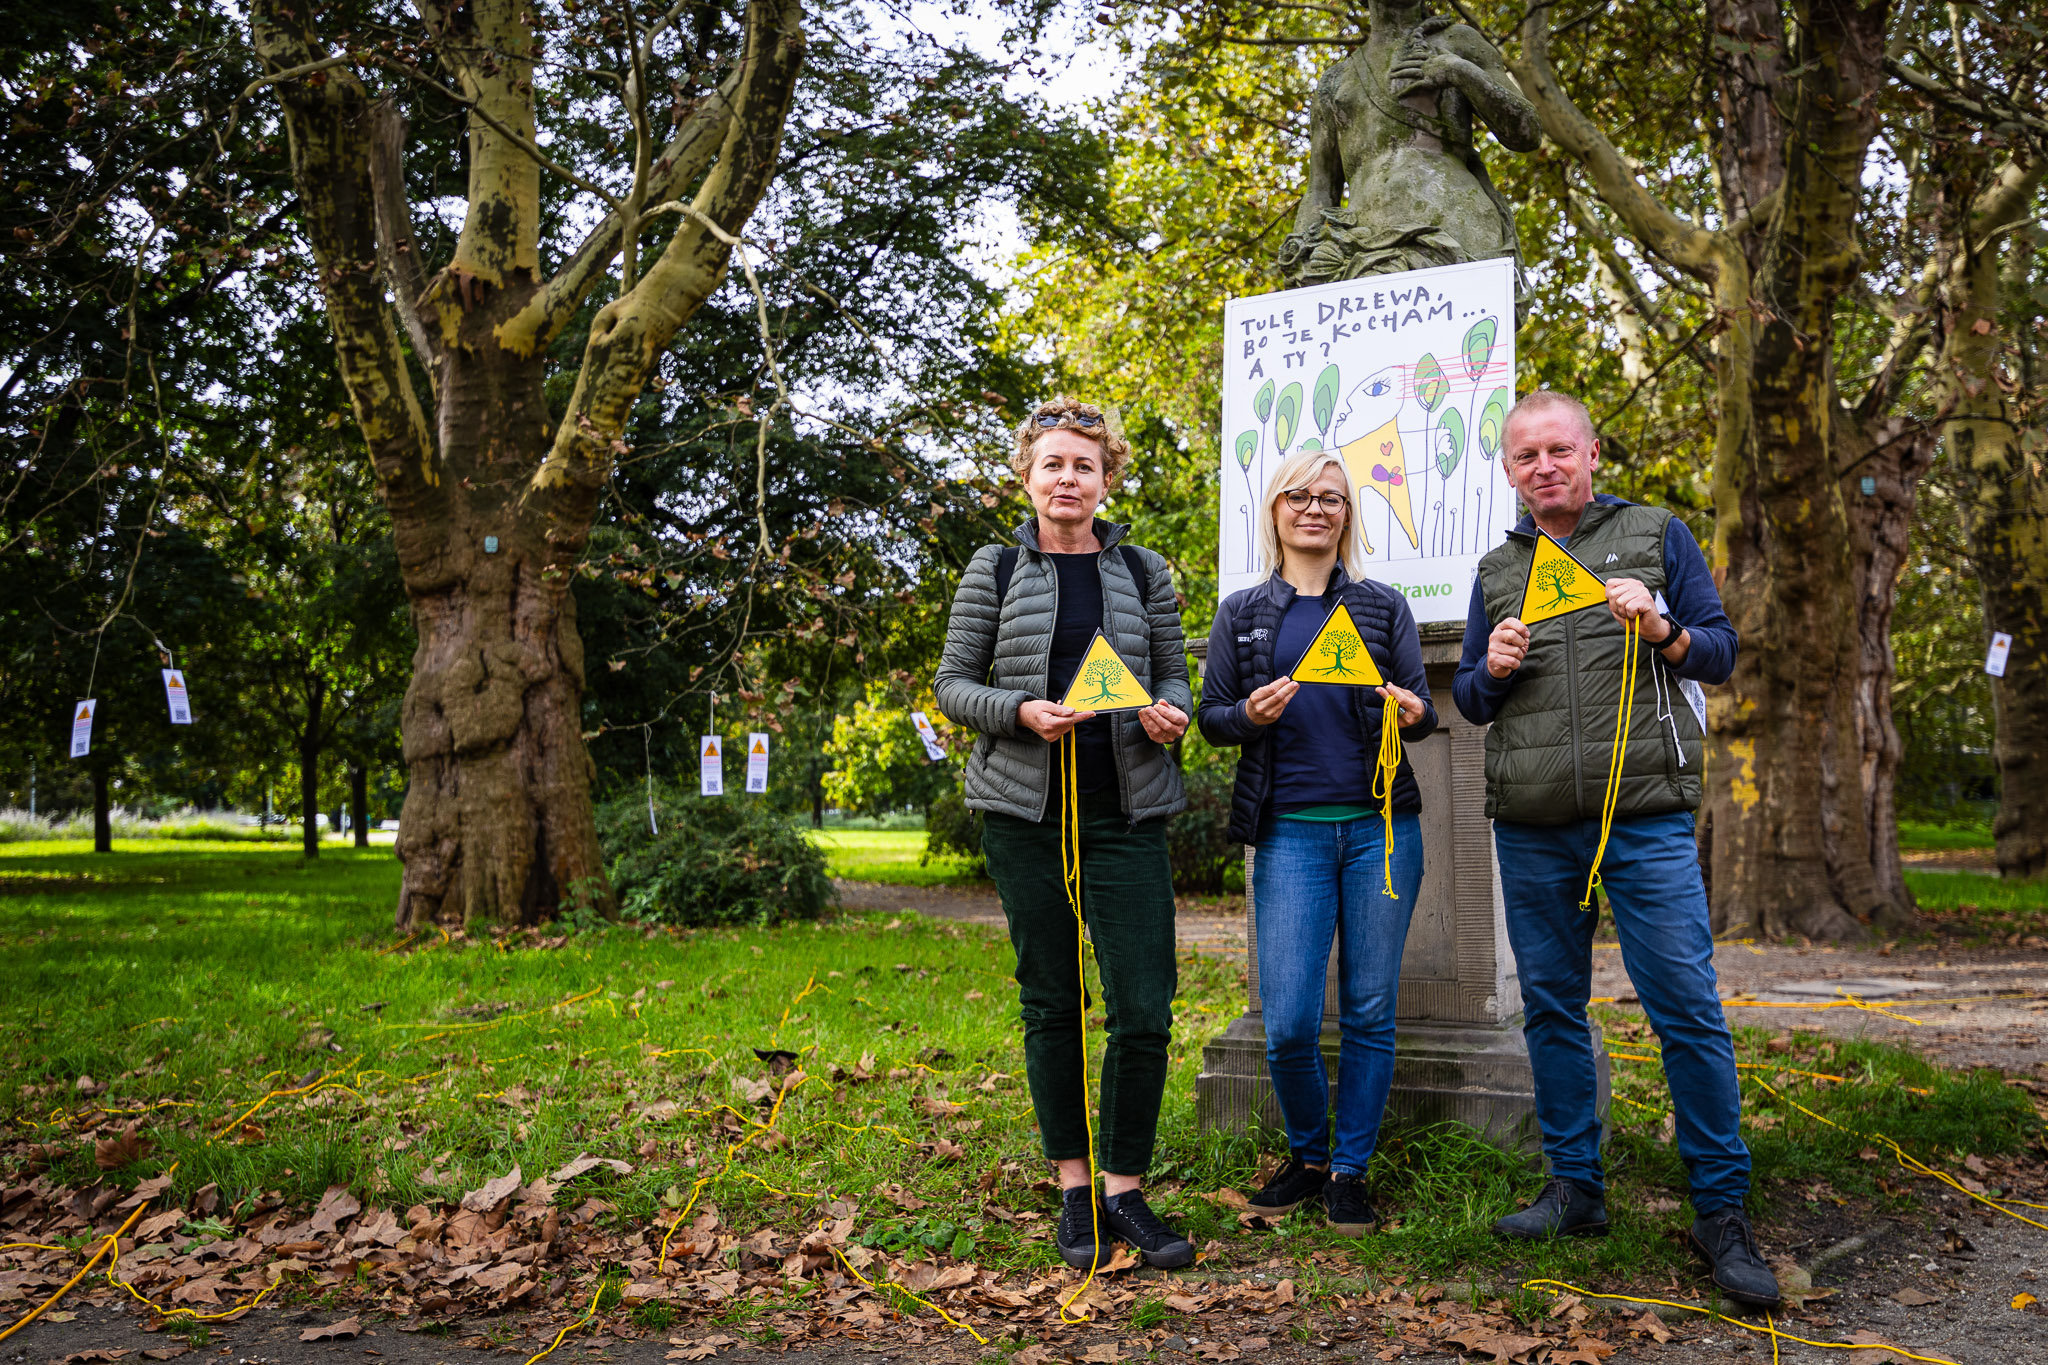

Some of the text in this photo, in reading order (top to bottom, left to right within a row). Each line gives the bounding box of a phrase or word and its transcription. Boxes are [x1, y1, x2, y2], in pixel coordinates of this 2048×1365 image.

[1240, 286, 1443, 336] TULĘ DRZEWA,
[1243, 336, 1268, 359] BO
[1282, 329, 1314, 345] JE
[1248, 358, 1264, 380] A
